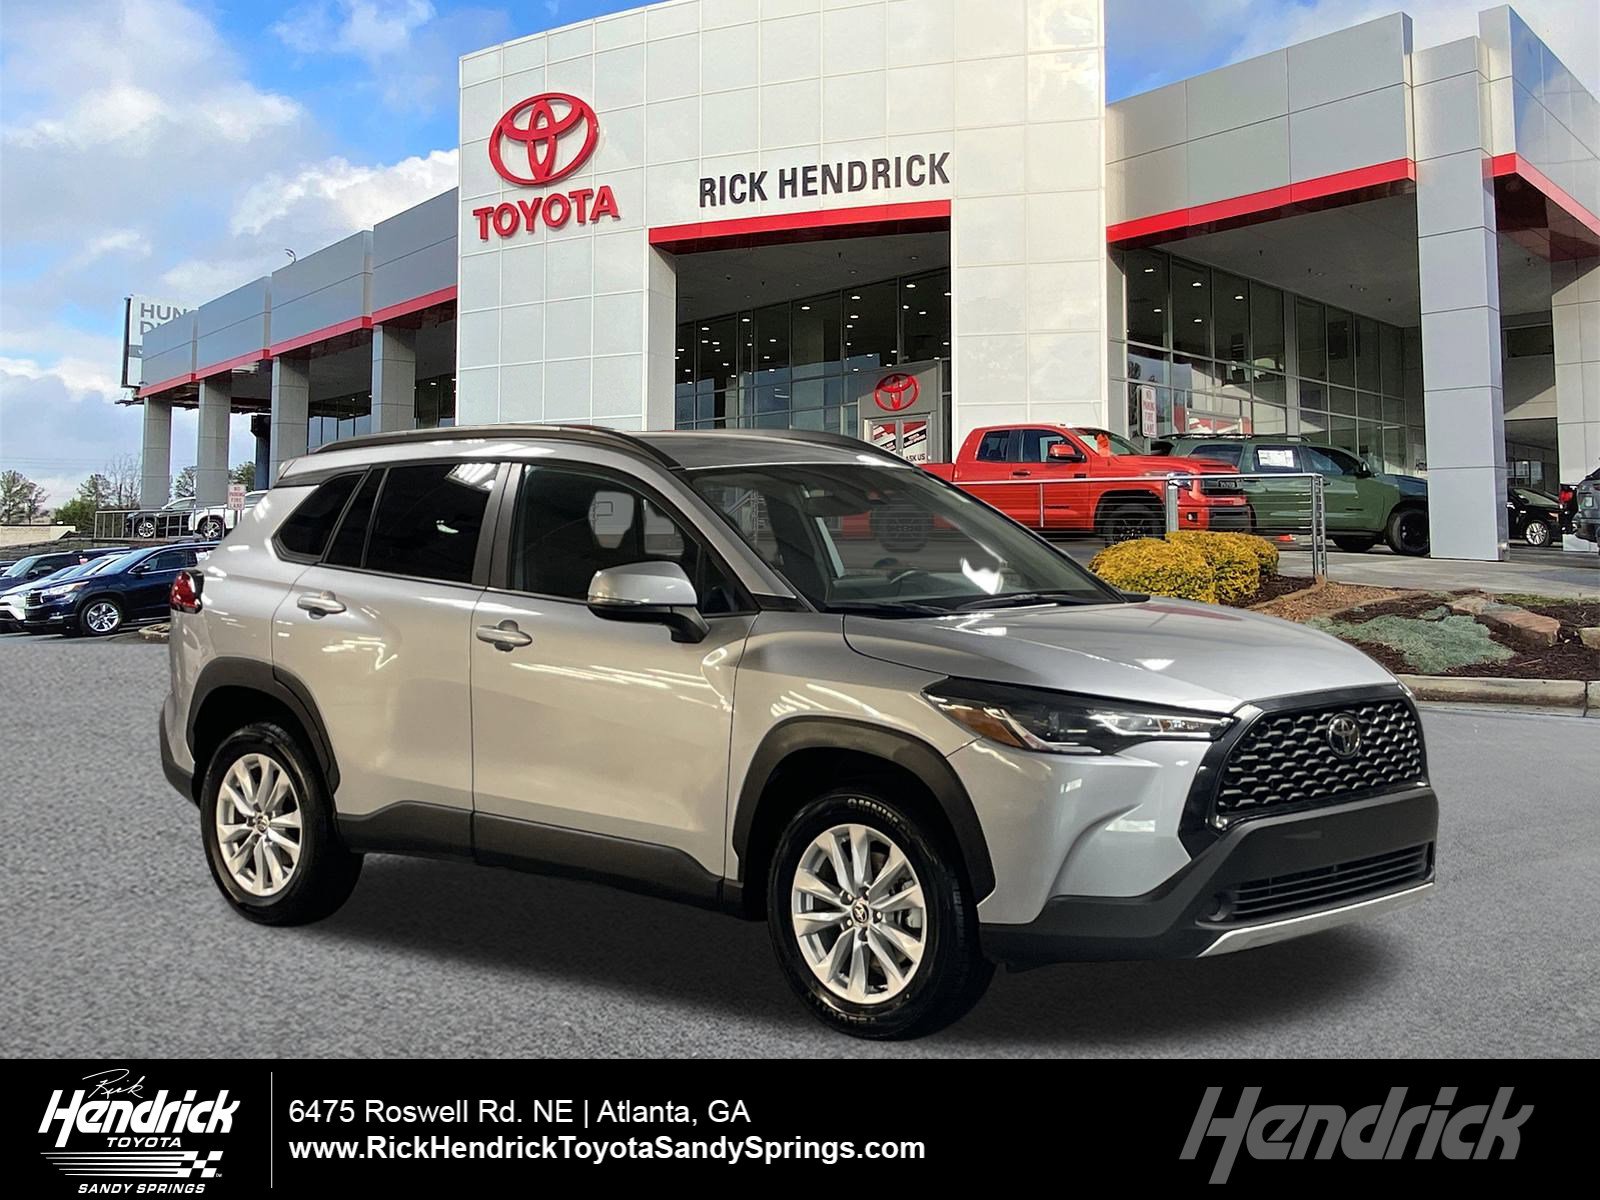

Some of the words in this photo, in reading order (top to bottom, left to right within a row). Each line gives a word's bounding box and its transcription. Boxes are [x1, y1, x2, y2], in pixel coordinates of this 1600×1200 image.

[699, 169, 769, 208] RICK
[778, 151, 951, 200] HENDRICK
[472, 184, 621, 241] TOYOTA
[917, 453, 926, 461] US
